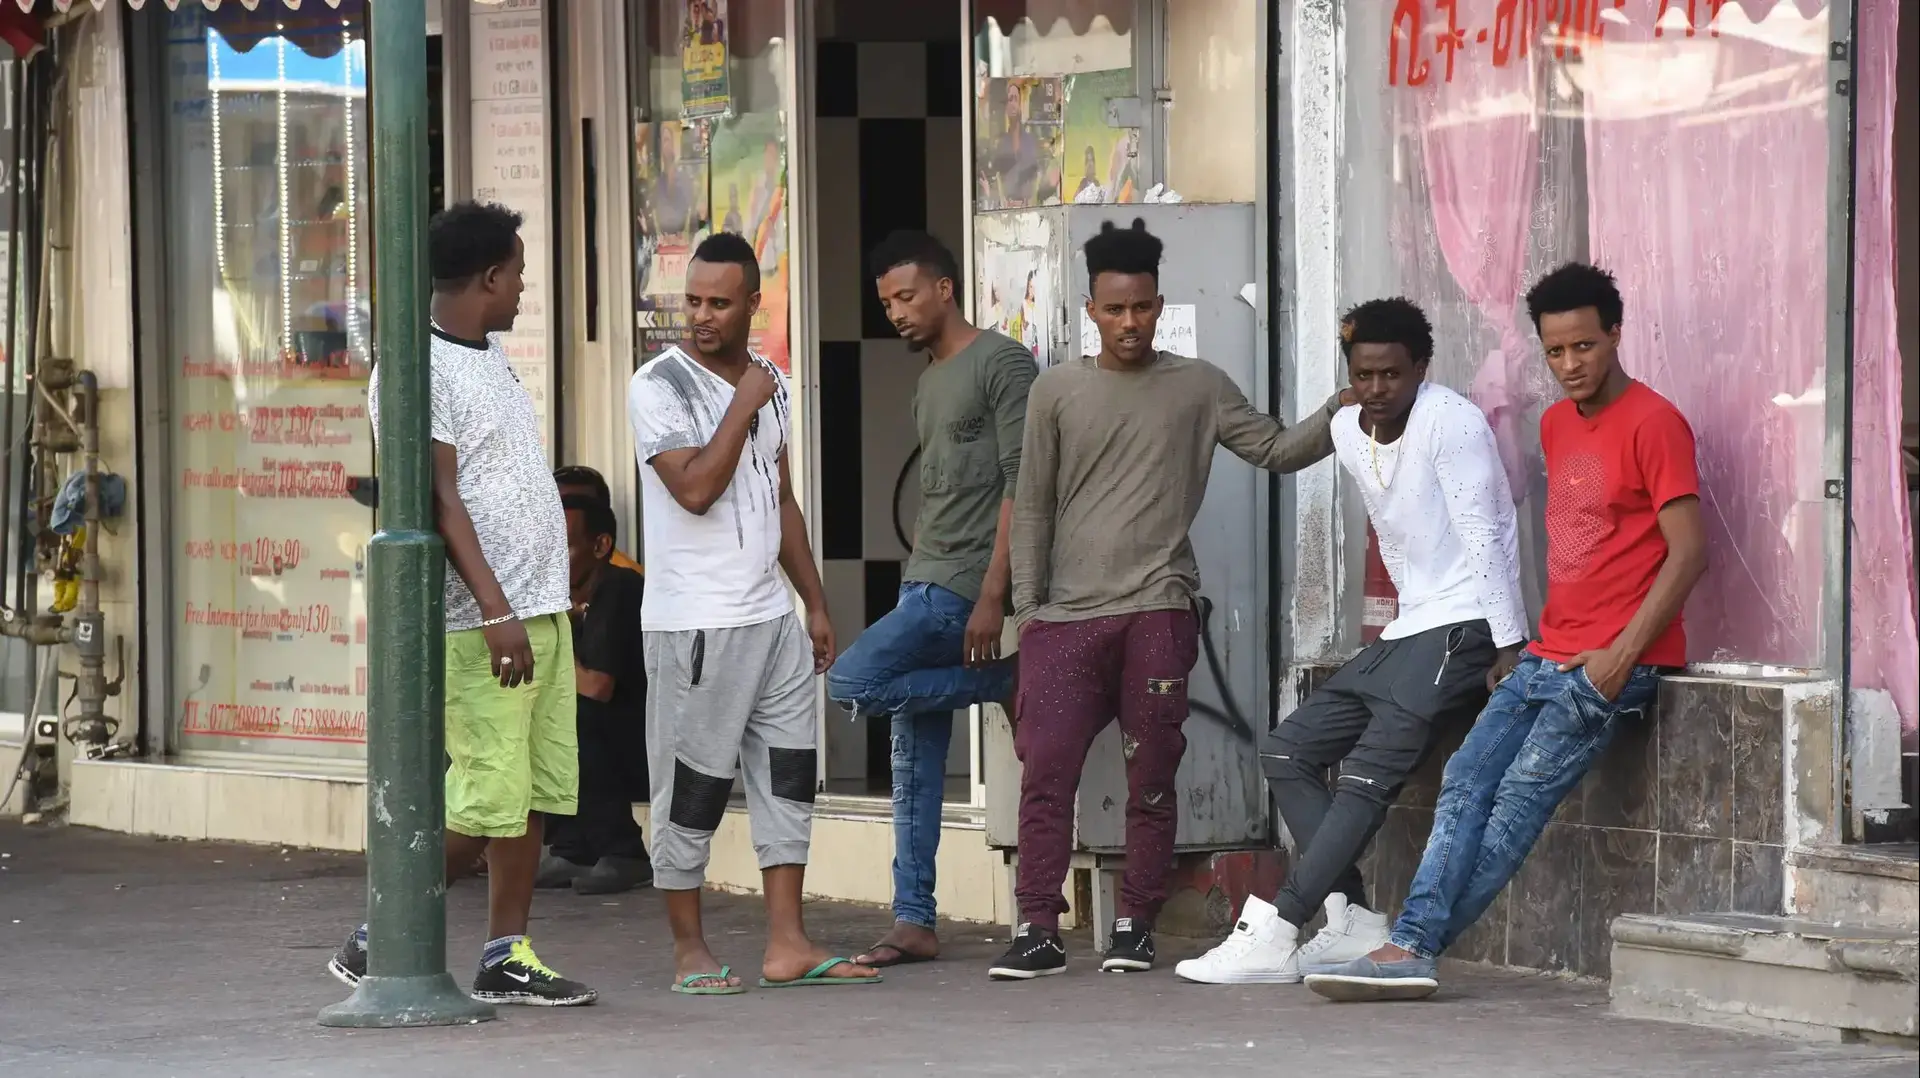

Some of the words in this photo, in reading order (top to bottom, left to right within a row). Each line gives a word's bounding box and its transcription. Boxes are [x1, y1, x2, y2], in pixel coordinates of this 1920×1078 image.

[255, 536, 270, 566] 10
[285, 538, 300, 569] 90
[184, 601, 201, 626] Free
[206, 602, 244, 629] Internet
[244, 605, 260, 633] for
[306, 604, 330, 634] 130
